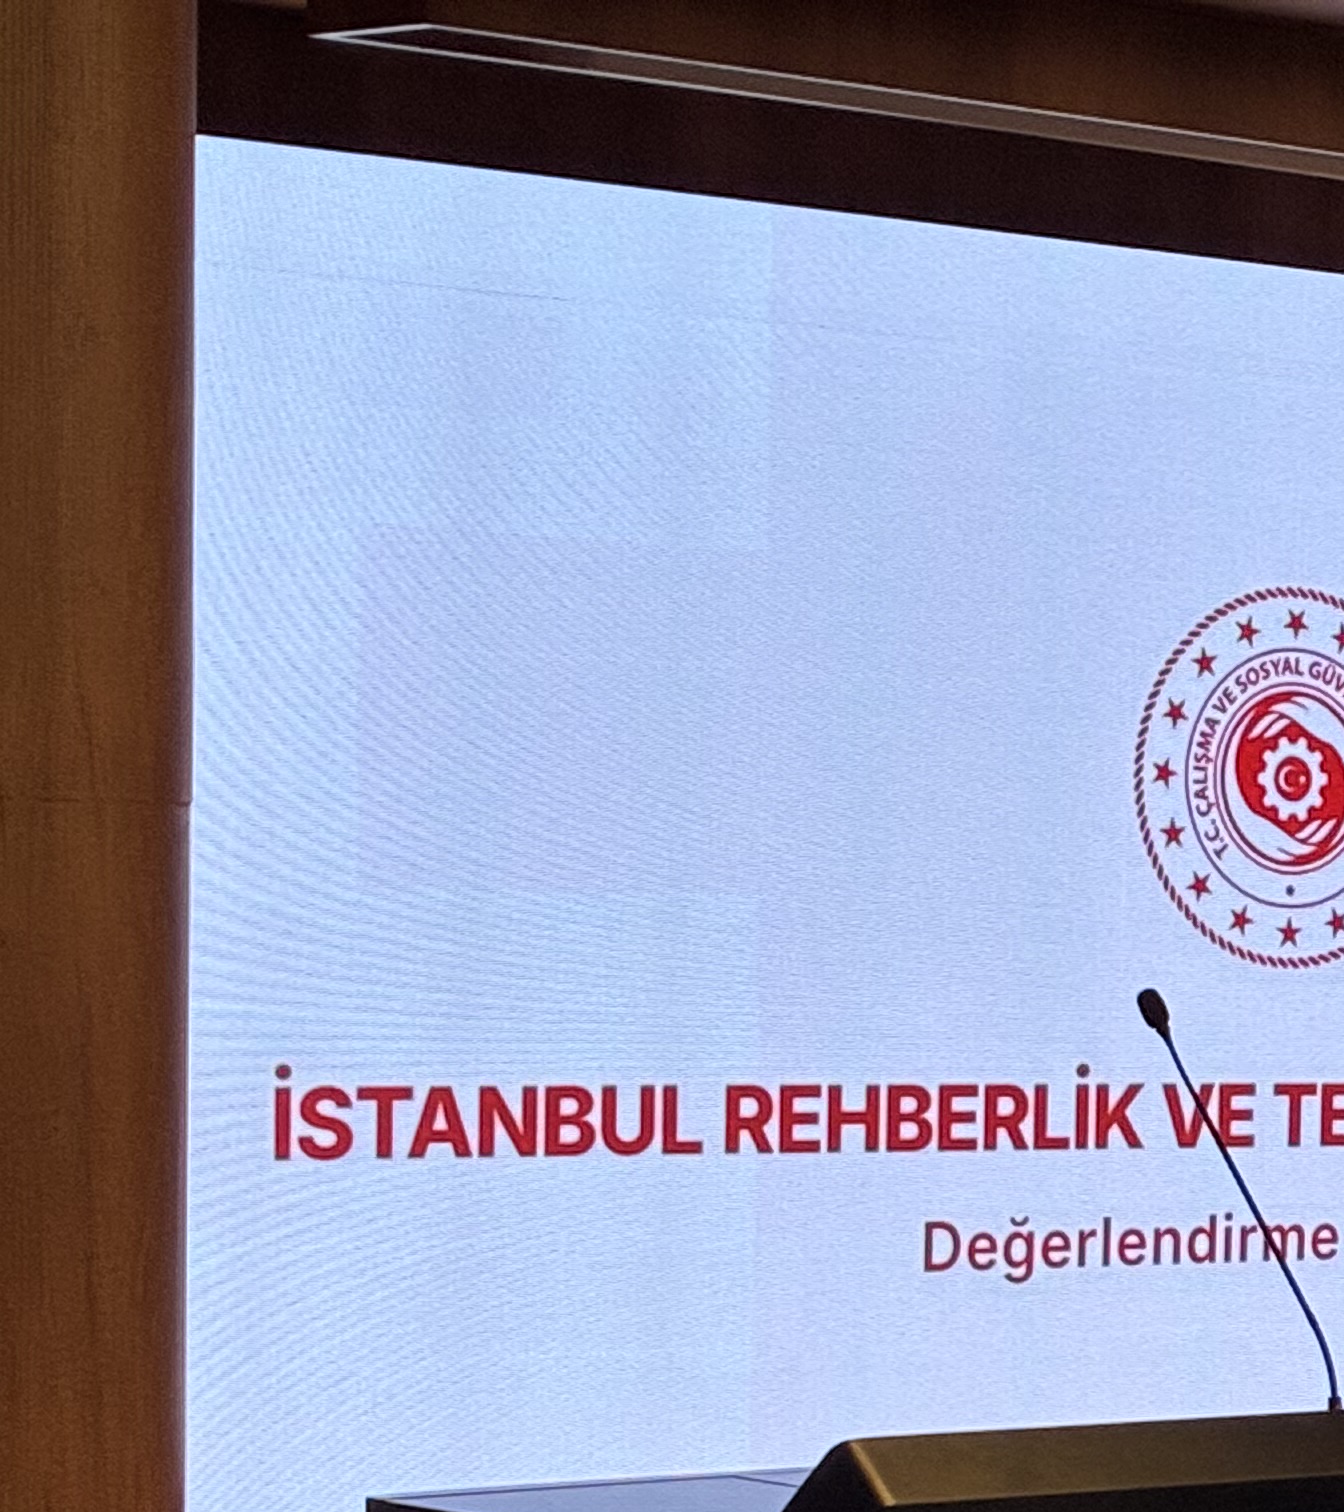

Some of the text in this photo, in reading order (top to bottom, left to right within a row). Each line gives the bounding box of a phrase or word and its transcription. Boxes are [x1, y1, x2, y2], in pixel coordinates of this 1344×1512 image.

[1193, 717, 1222, 817] ÇALIŞMA
[1212, 686, 1239, 715] VE
[1235, 656, 1305, 695] SOSYAL
[274, 1064, 703, 1161] İSTANBUL
[724, 1063, 1144, 1155] REHBERLİK
[1162, 1082, 1257, 1149] VE
[922, 1214, 1340, 1285] Değerlendirme
